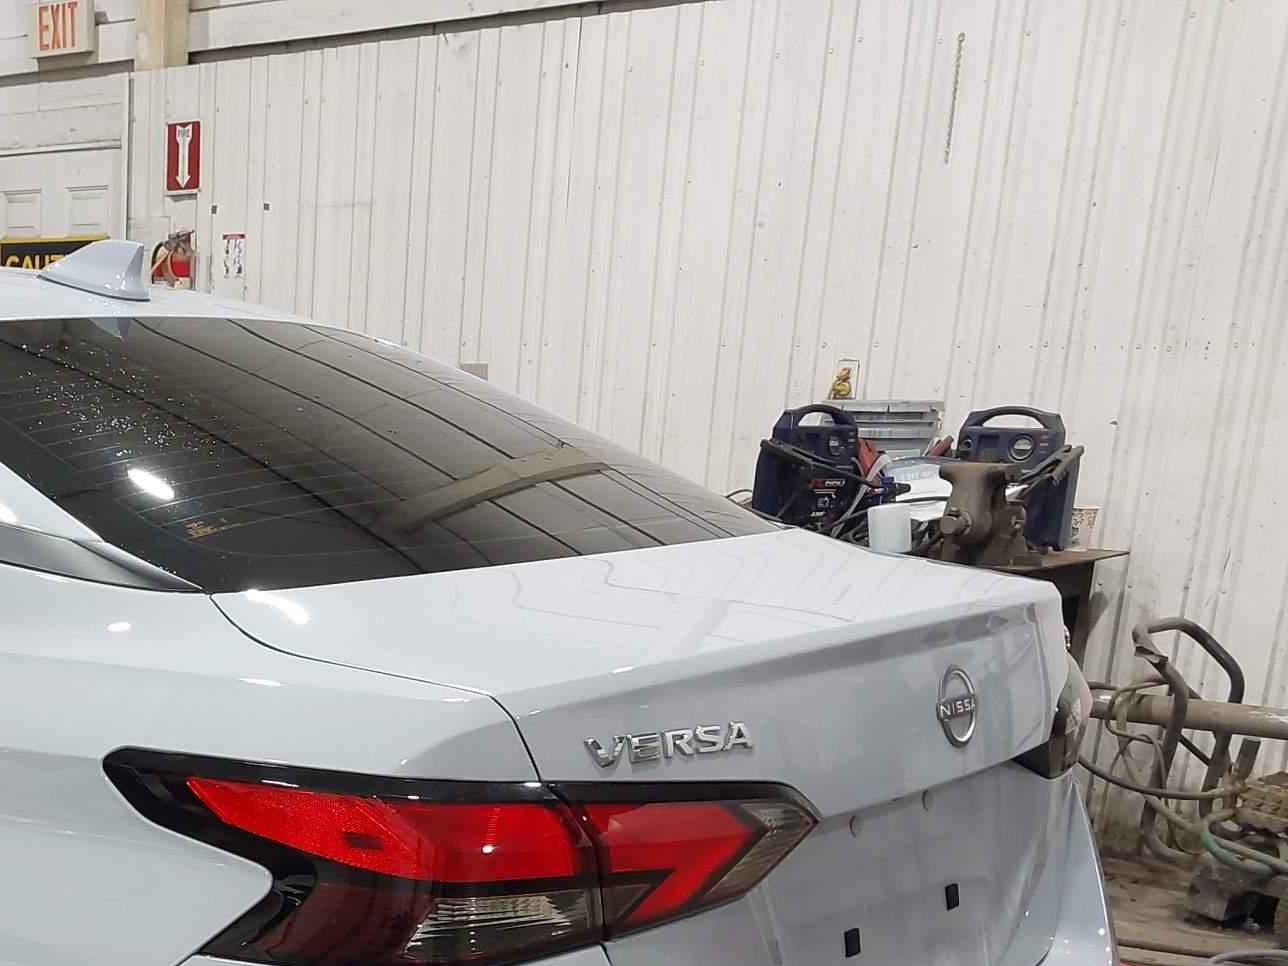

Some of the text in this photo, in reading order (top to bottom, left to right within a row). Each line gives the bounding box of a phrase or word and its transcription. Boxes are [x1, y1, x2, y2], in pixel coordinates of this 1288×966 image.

[38, 1, 78, 51] EXIT
[6, 254, 66, 269] CAUT
[939, 699, 976, 717] NISSA
[583, 721, 753, 768] VERSA
